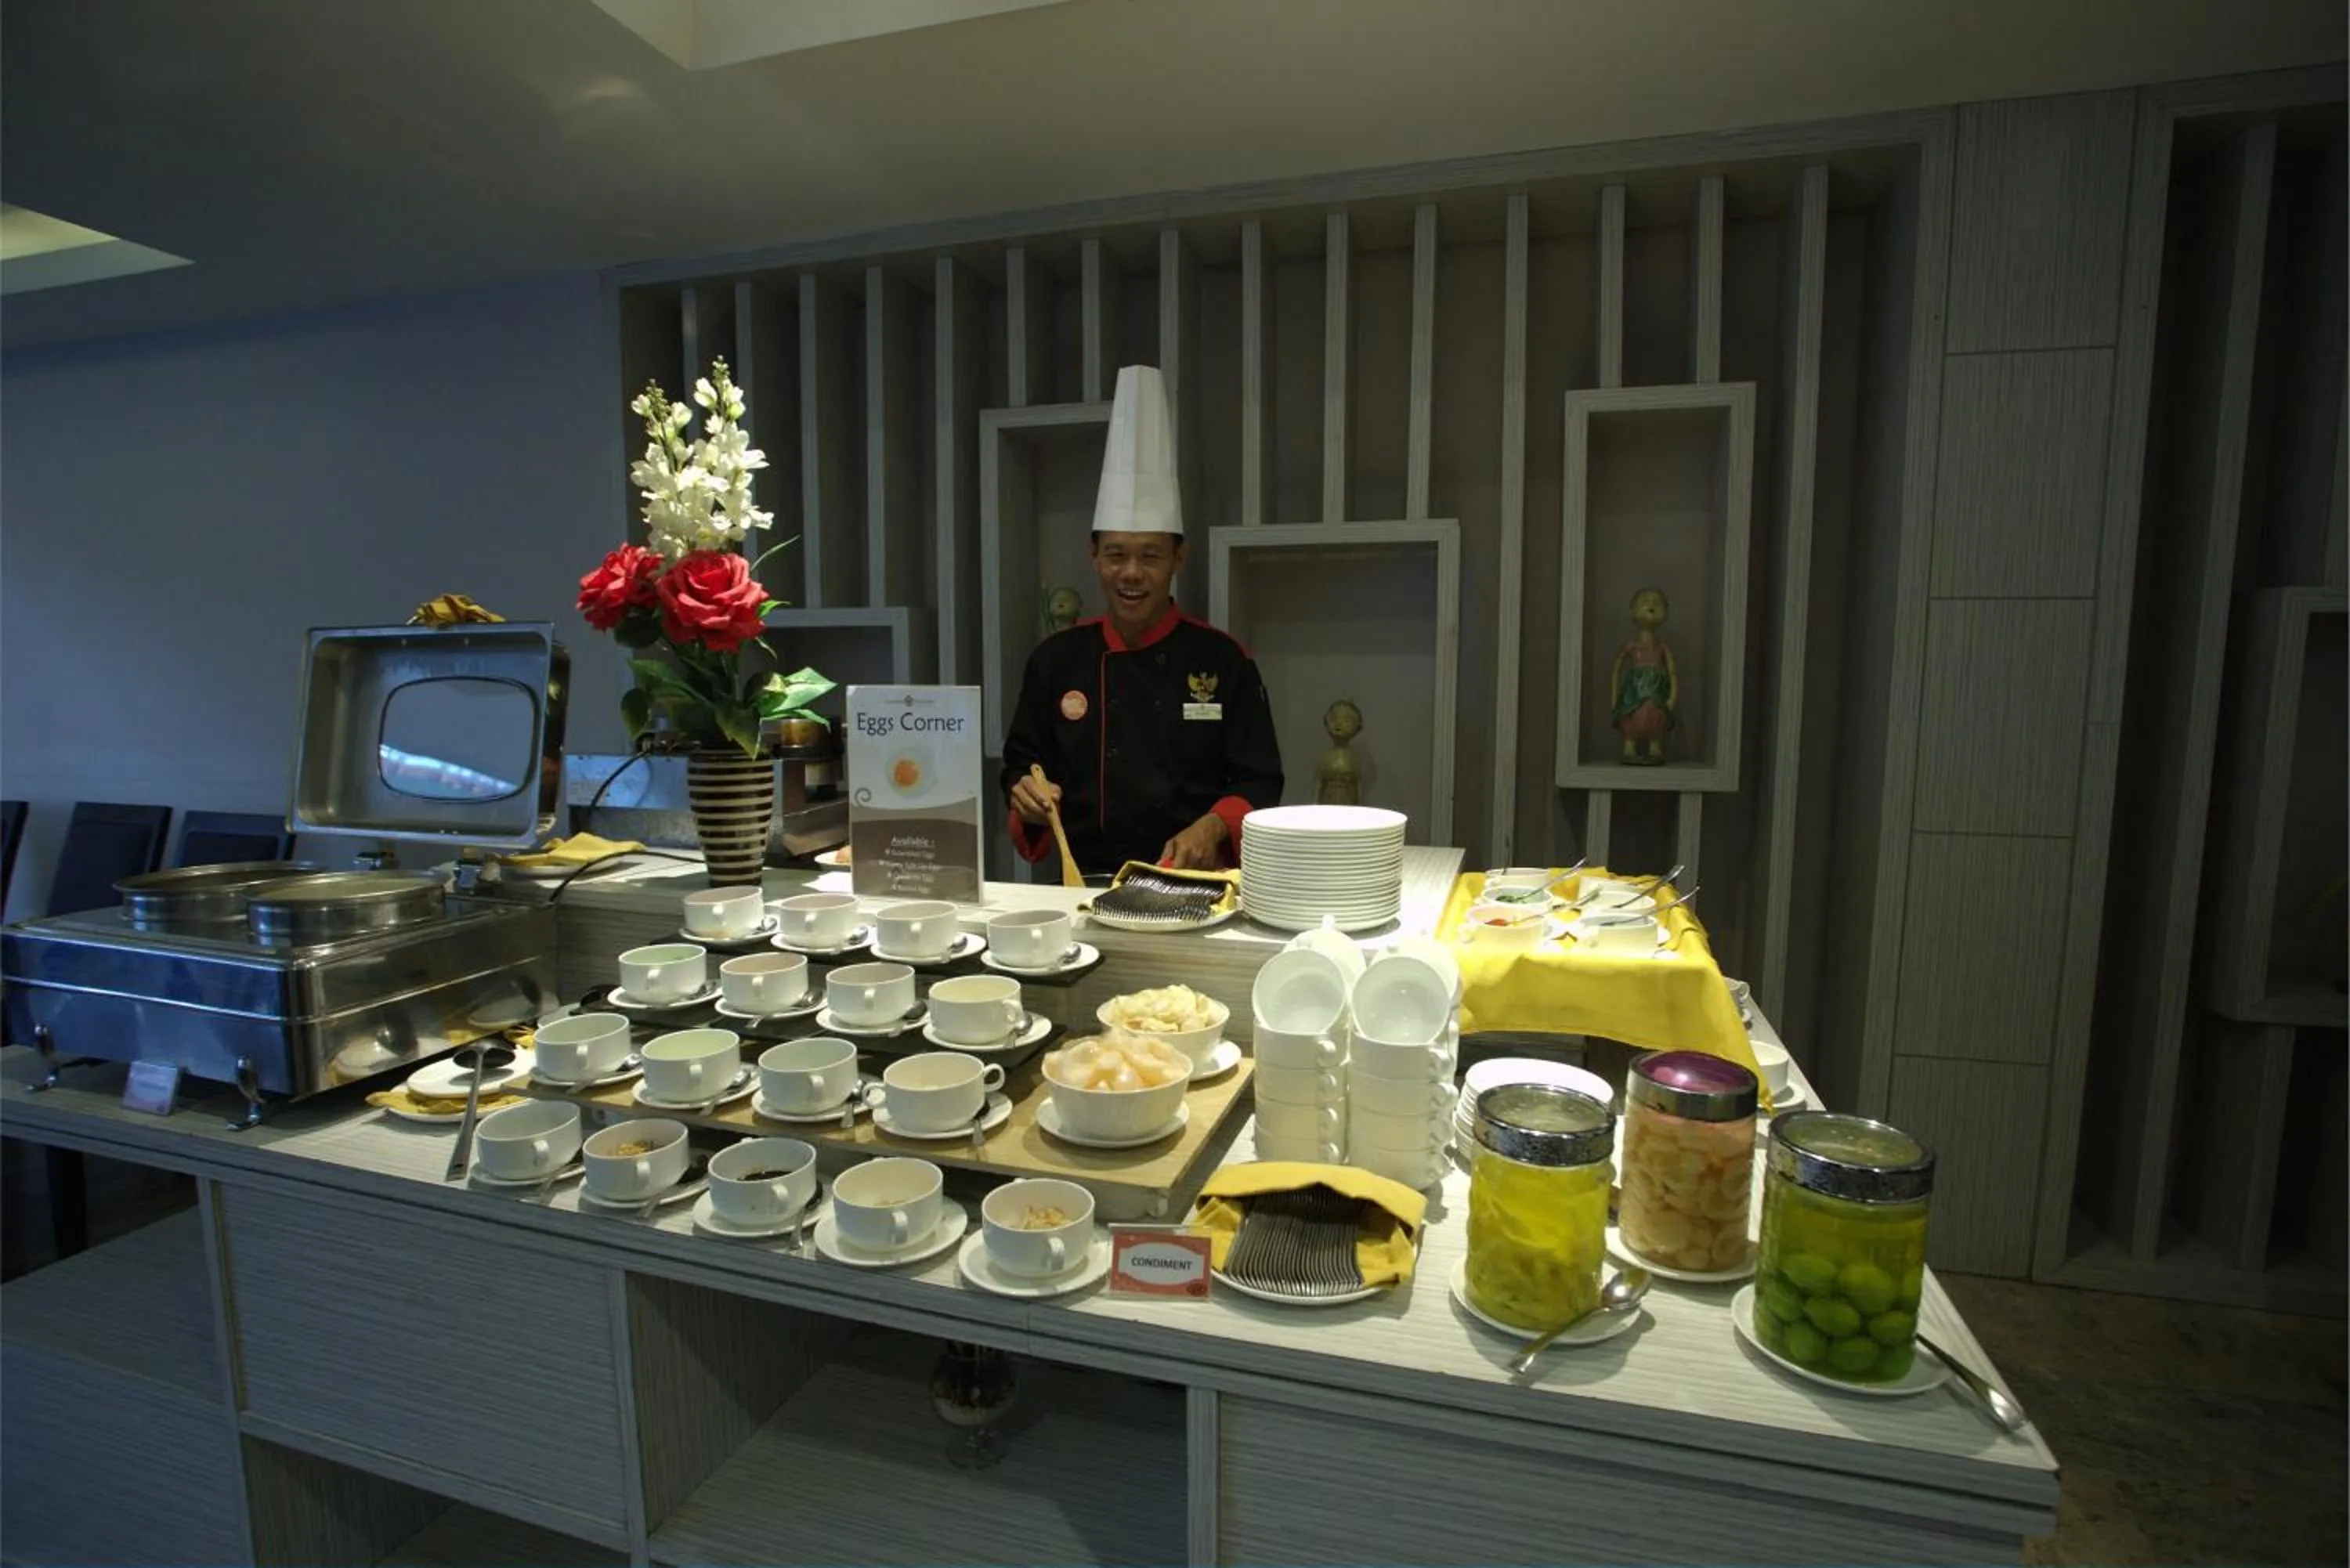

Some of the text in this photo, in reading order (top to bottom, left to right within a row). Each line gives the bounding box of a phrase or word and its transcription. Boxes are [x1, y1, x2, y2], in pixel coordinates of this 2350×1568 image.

[857, 711, 965, 736] Eggs Corner
[1130, 1256, 1193, 1270] CONDIMENT
